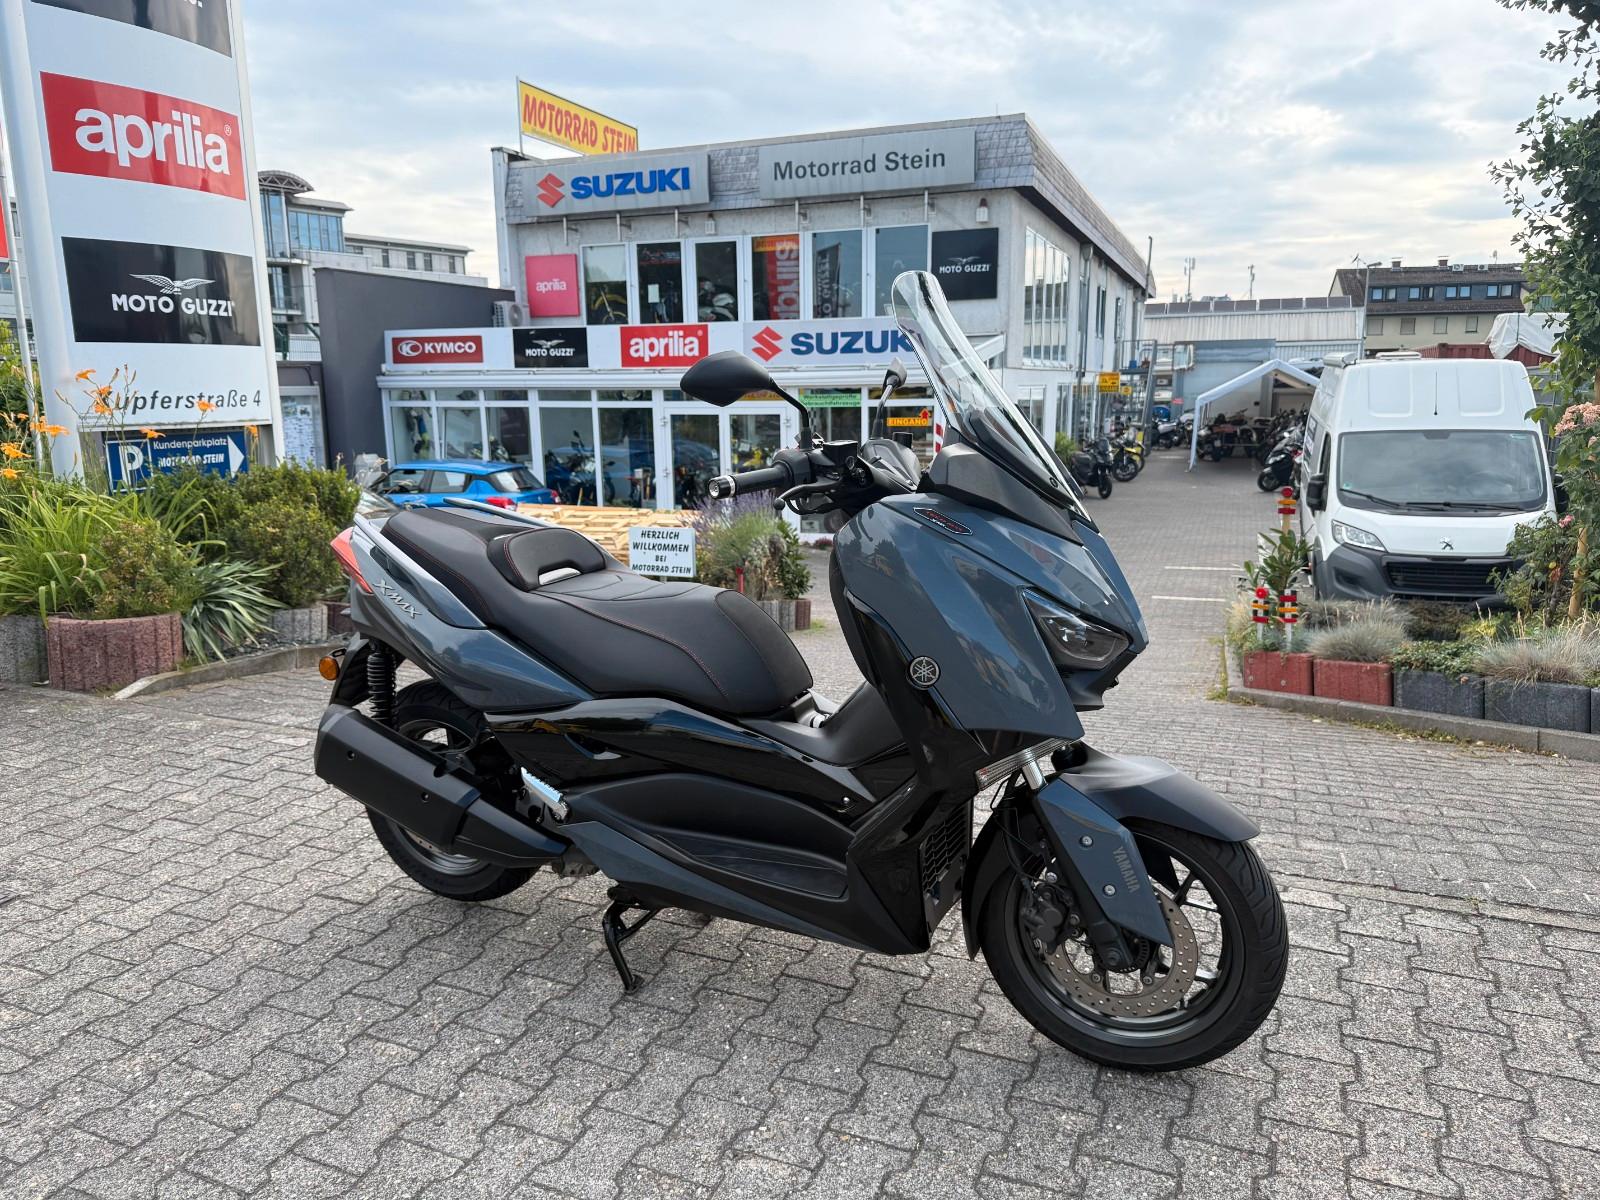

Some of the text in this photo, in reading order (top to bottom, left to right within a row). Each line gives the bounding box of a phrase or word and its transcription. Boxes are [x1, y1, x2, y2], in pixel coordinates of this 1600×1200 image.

[523, 94, 598, 148] MOTORRAD
[75, 108, 230, 175] aprilia
[773, 148, 946, 181] Motorrad Stein
[570, 166, 690, 200] SUZUKI
[939, 264, 990, 274] MOTO GUZZI
[536, 279, 568, 293] aprilia
[111, 293, 233, 317] MOTO GUZZI
[424, 341, 477, 354] KYMCO
[629, 330, 700, 362] aprilia
[791, 330, 914, 356] SUZUK
[525, 347, 574, 357] MOTO GUZZI
[253, 389, 261, 407] 4
[153, 437, 228, 450] Kundenparkplatz
[203, 453, 225, 464] STEIN
[641, 530, 680, 540] HERZLICH
[632, 541, 689, 553] WILLKOMMEN
[655, 555, 667, 563] BEI
[632, 564, 691, 574] MOTORRAD STEIN
[1113, 846, 1140, 893] YAMAHA
